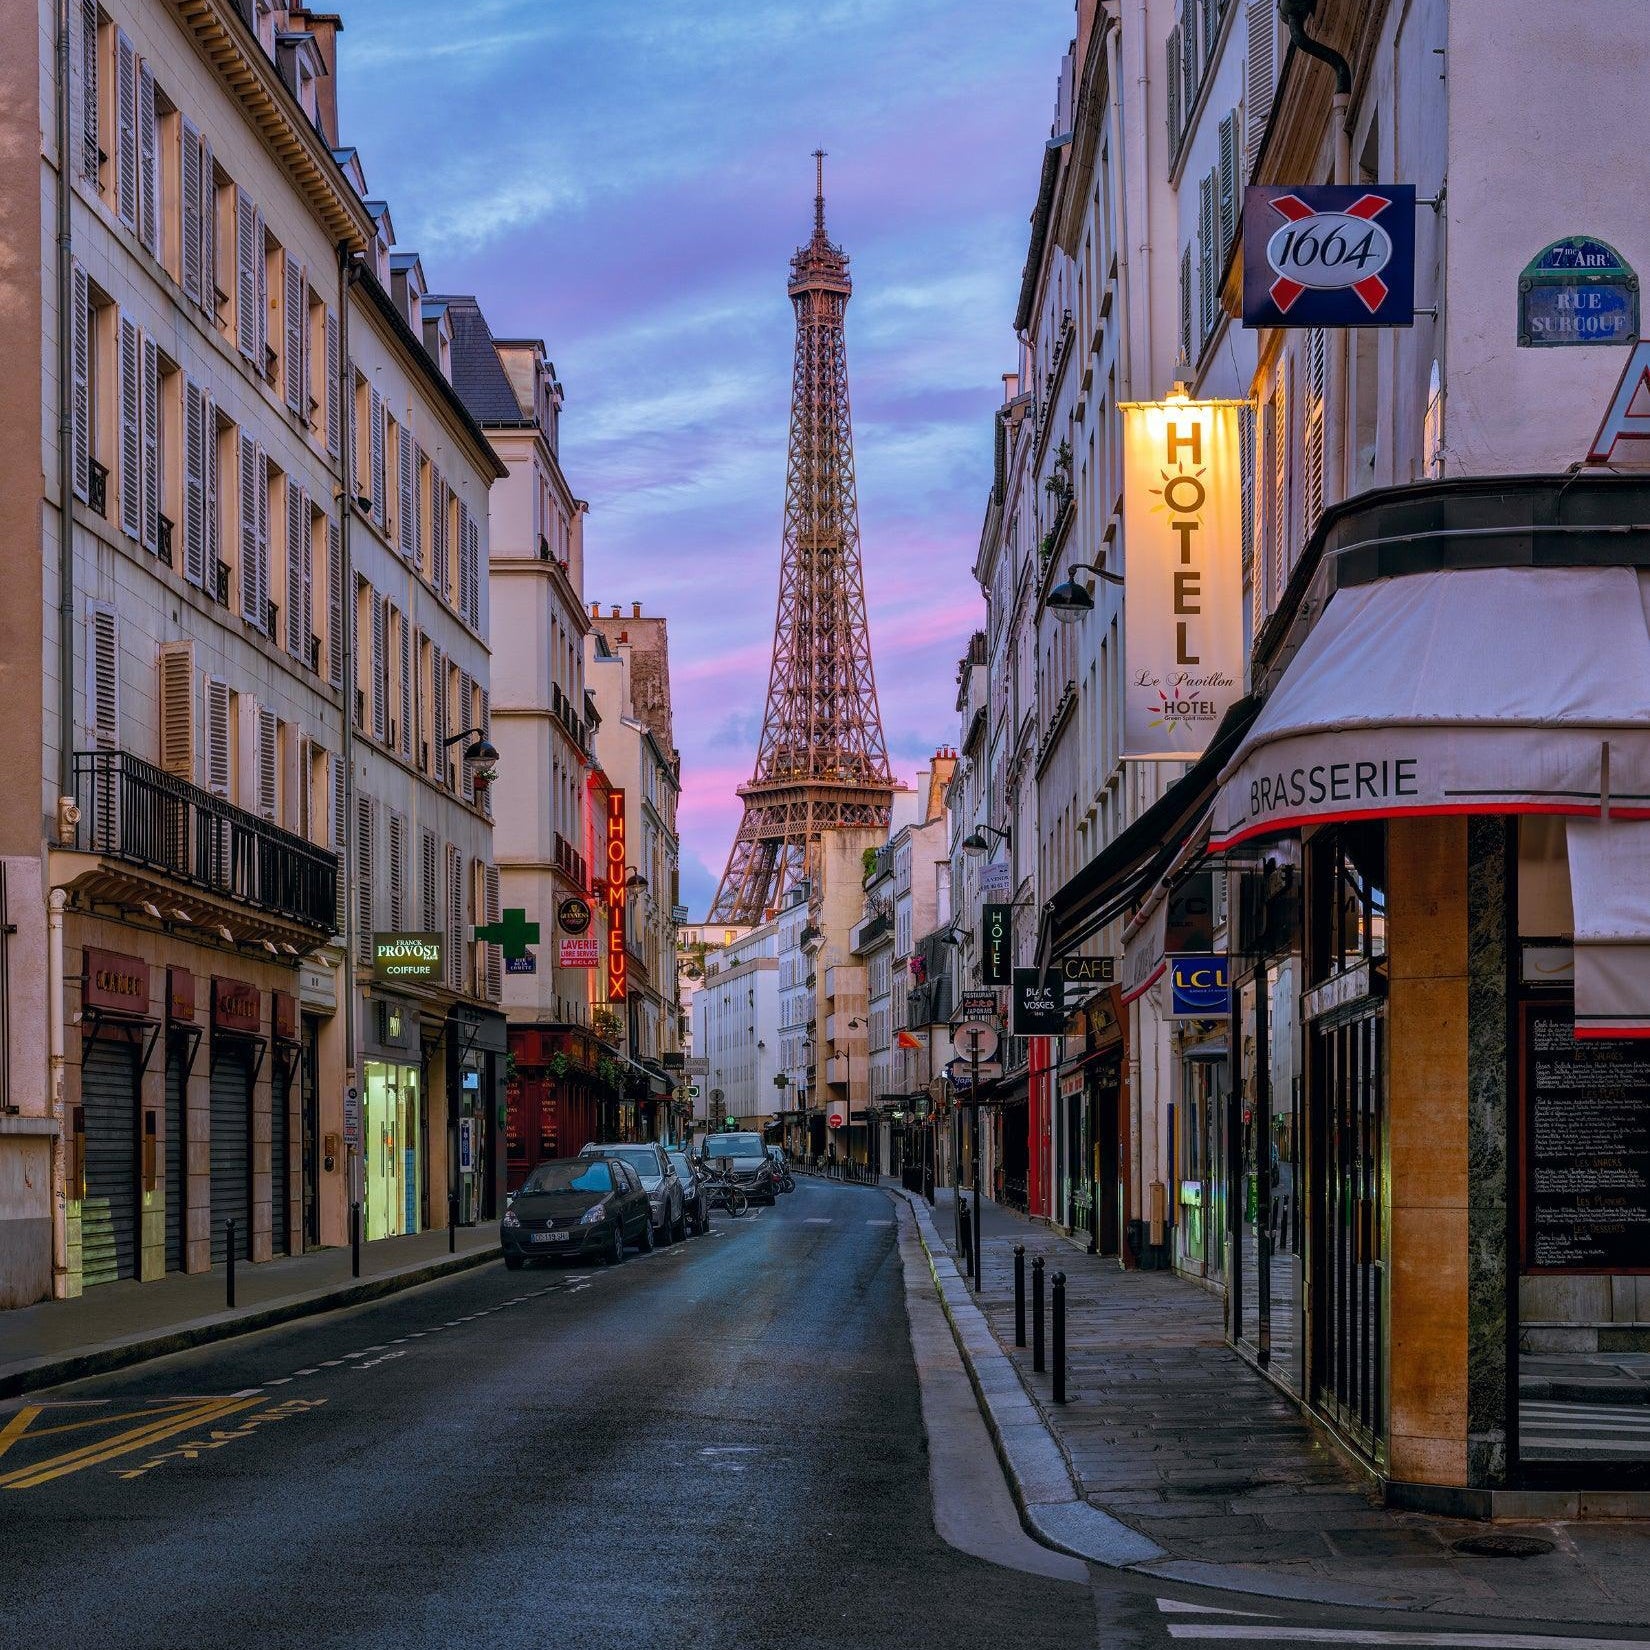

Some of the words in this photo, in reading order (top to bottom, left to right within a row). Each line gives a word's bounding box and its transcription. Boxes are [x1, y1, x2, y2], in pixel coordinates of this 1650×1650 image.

[1279, 222, 1380, 269] 1664
[1557, 293, 1602, 309] RUE
[1532, 316, 1626, 332] SURCOUF
[1164, 422, 1206, 665] HOTEL
[1133, 668, 1160, 687] Le
[1166, 671, 1234, 687] Pavillon
[1164, 701, 1217, 714] HOTEL
[1251, 759, 1418, 816] BRASSERIE
[609, 795, 625, 997] THOUMIEUX
[377, 945, 440, 957] PROVOST
[561, 940, 597, 950] LAVERIE
[991, 911, 1004, 978] HÔTEL
[386, 966, 431, 974] COIFFURE
[1065, 960, 1112, 978] CAFE
[1176, 970, 1230, 988] LCL
[1023, 1002, 1055, 1010] VOSGES
